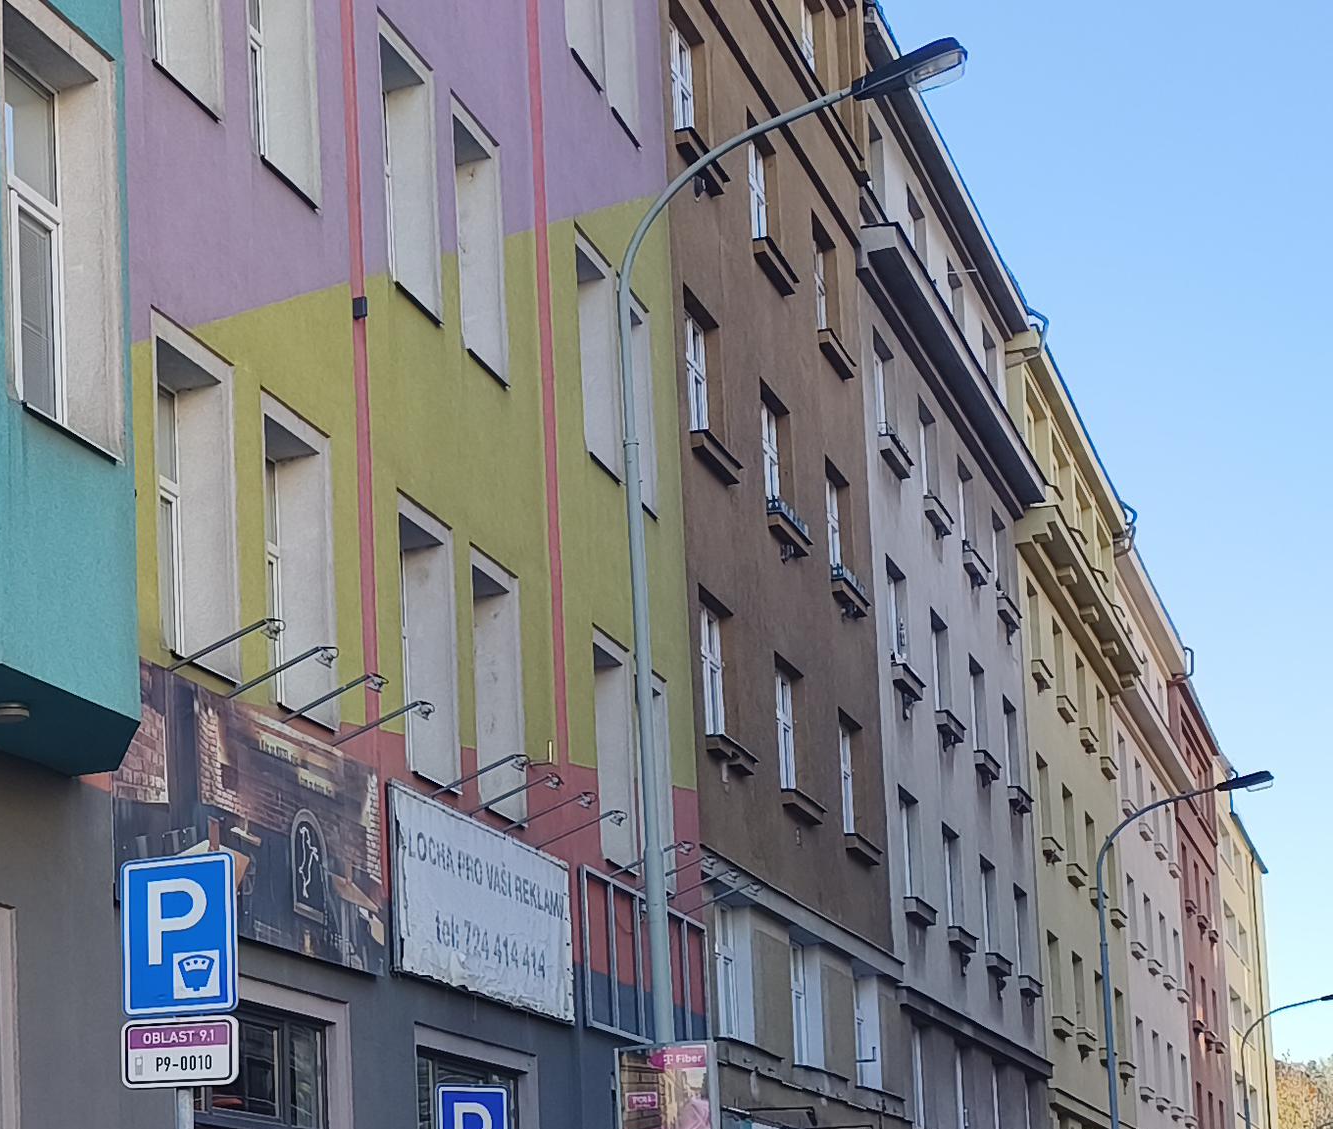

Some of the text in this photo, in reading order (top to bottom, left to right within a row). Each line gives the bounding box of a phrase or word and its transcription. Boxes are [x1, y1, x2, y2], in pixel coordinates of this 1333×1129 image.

[407, 828, 565, 921] LOCHA PRO VAŠI REKLAMY
[147, 878, 207, 966] P
[464, 919, 489, 960] 724
[493, 933, 518, 968] 414
[522, 943, 546, 979] 414
[142, 1029, 215, 1045] OBLAST 9.1
[156, 1055, 212, 1072] P9-0010
[676, 1054, 702, 1063] Fiber
